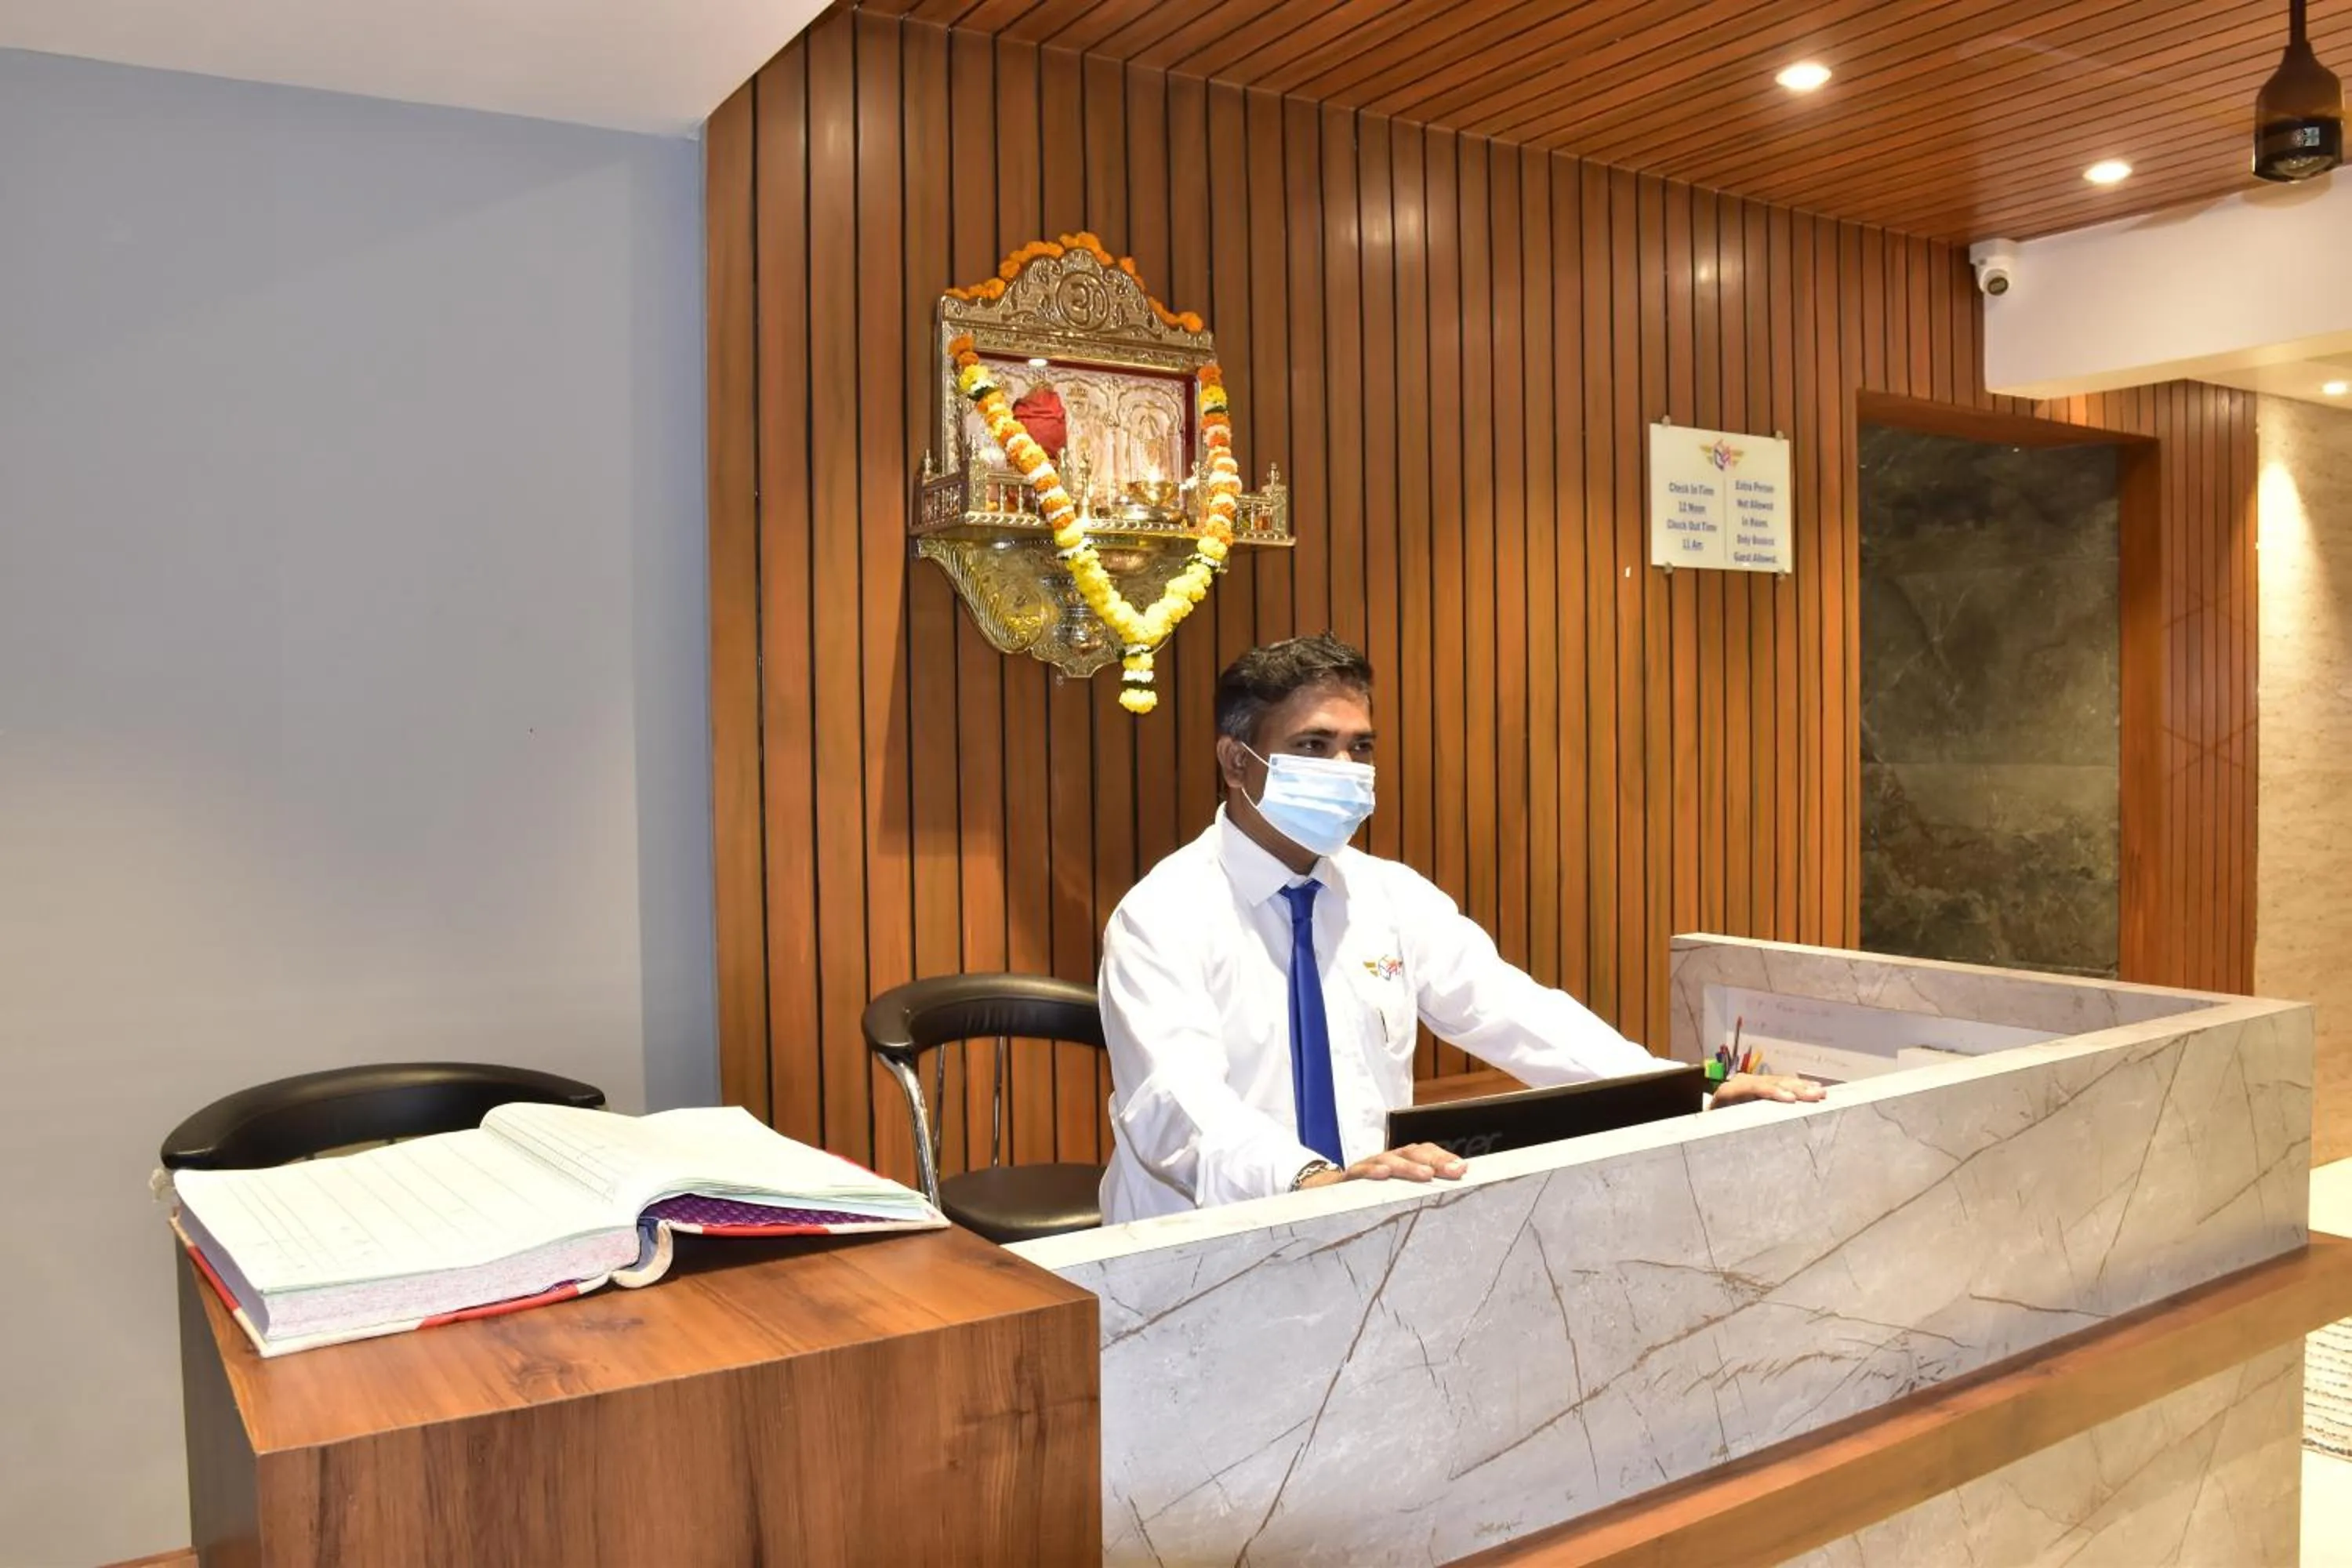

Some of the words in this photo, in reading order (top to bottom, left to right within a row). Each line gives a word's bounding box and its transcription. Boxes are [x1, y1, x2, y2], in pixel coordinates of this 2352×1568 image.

[1668, 482, 1689, 494] Check
[1699, 484, 1715, 496] Time
[1735, 480, 1752, 492] Extra
[1679, 501, 1687, 513] 12
[1737, 498, 1749, 509] Not
[1750, 499, 1774, 511] Allowed
[1667, 518, 1686, 531] Check
[1688, 520, 1700, 532] Out
[1701, 521, 1717, 533] Time
